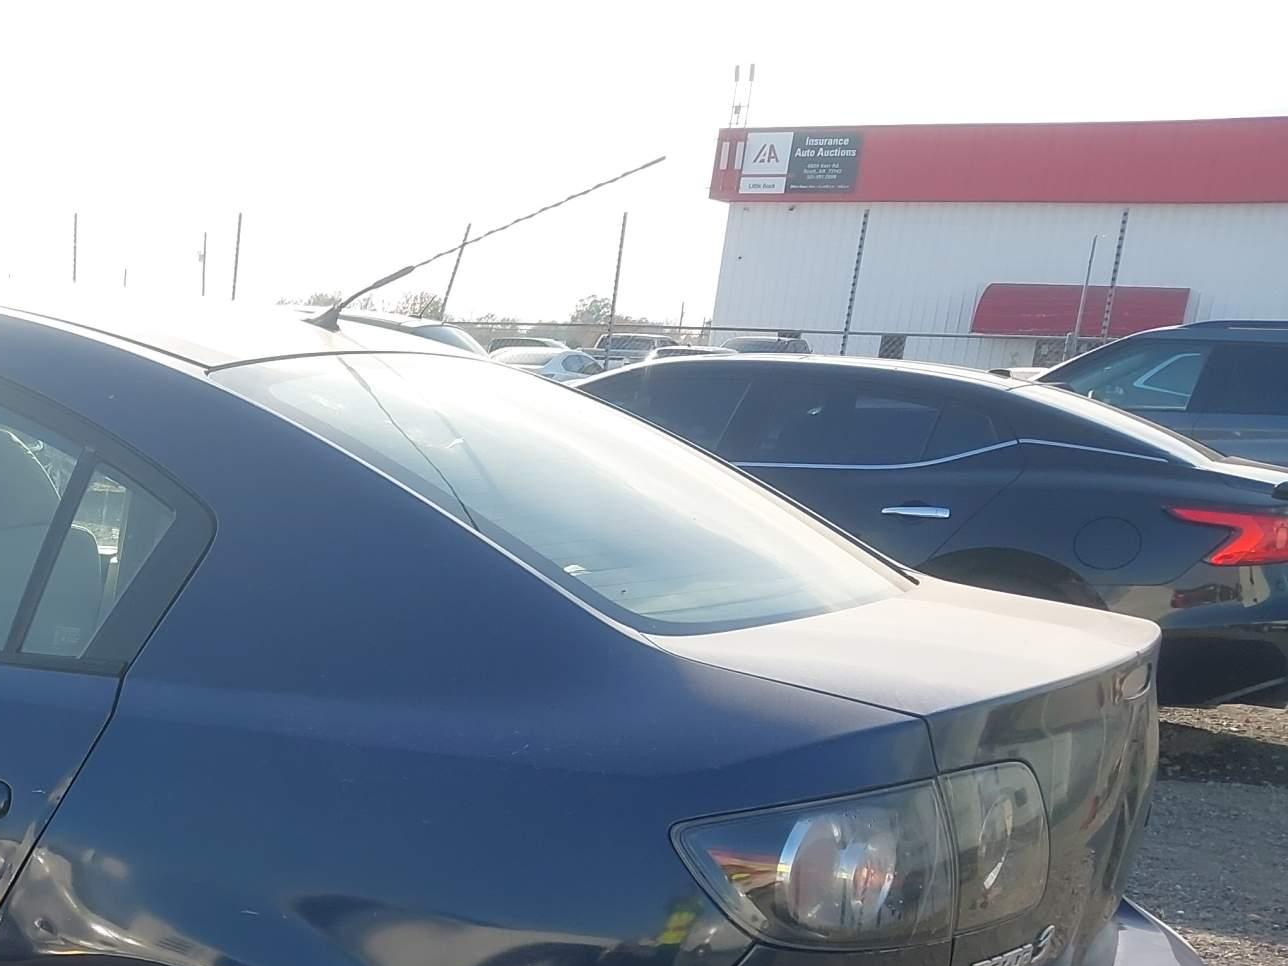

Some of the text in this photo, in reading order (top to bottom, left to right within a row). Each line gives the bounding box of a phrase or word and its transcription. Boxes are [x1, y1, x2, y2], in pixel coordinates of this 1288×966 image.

[805, 136, 849, 146] Insurance
[795, 148, 856, 157] Auto Auctions
